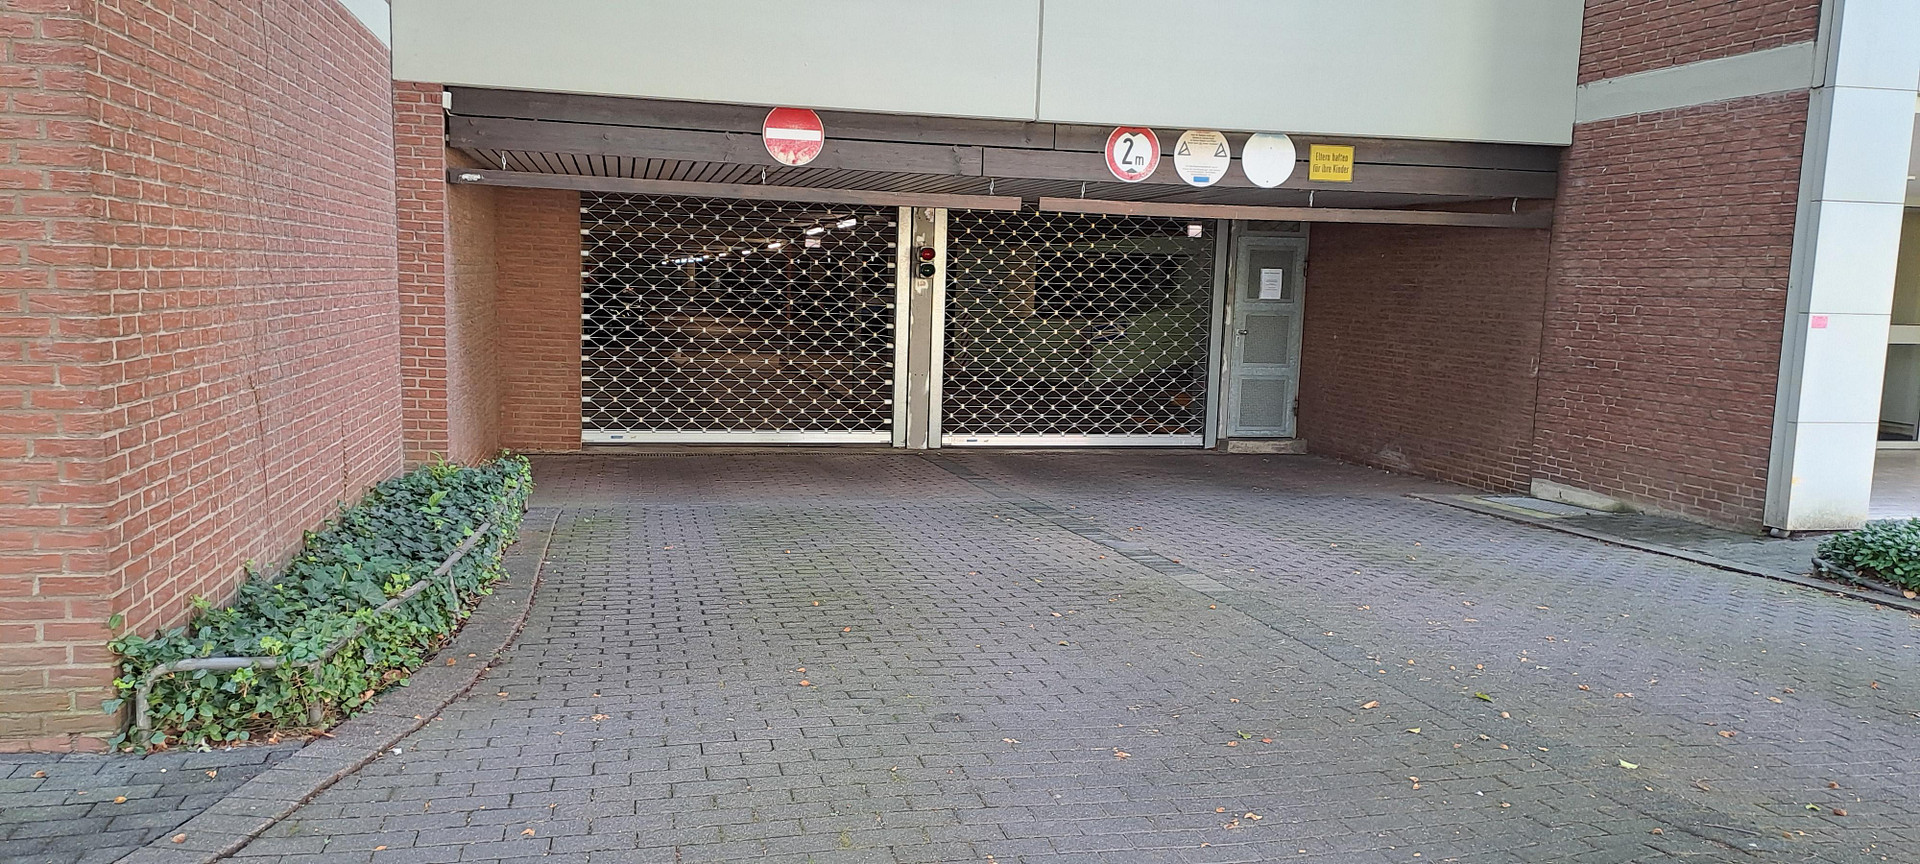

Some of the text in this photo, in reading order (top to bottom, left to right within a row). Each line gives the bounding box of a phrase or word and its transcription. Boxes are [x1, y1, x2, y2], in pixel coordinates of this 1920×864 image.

[1315, 151, 1348, 162] Eltern haften
[1312, 163, 1321, 173] für
[1333, 164, 1349, 174] Kinder
